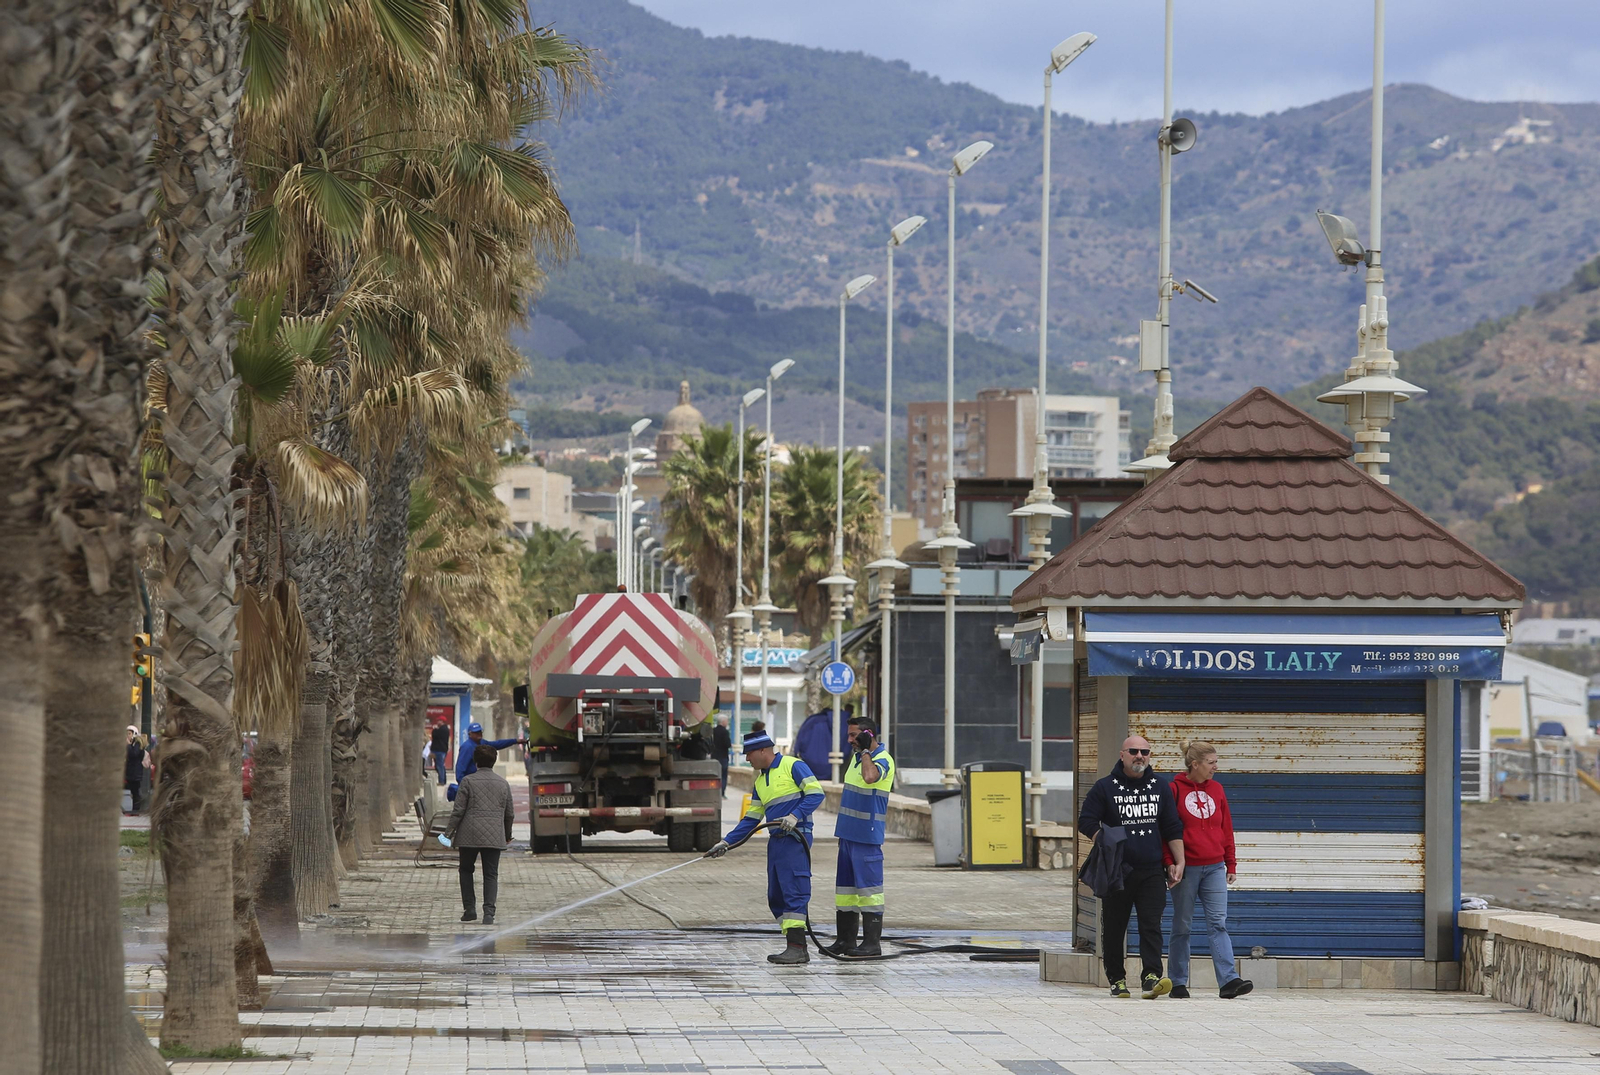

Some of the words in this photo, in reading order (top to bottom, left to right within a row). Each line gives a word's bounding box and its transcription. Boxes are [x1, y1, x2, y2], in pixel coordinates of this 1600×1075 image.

[1363, 651, 1386, 661] Tlf.:
[1389, 652, 1411, 661] 952
[1413, 652, 1436, 661] 320
[1438, 652, 1460, 661] 996
[1264, 651, 1342, 672] LALY
[539, 796, 558, 804] 0693
[1113, 795, 1137, 804] TRUST
[1139, 794, 1148, 803] IN
[1149, 794, 1160, 802] MY
